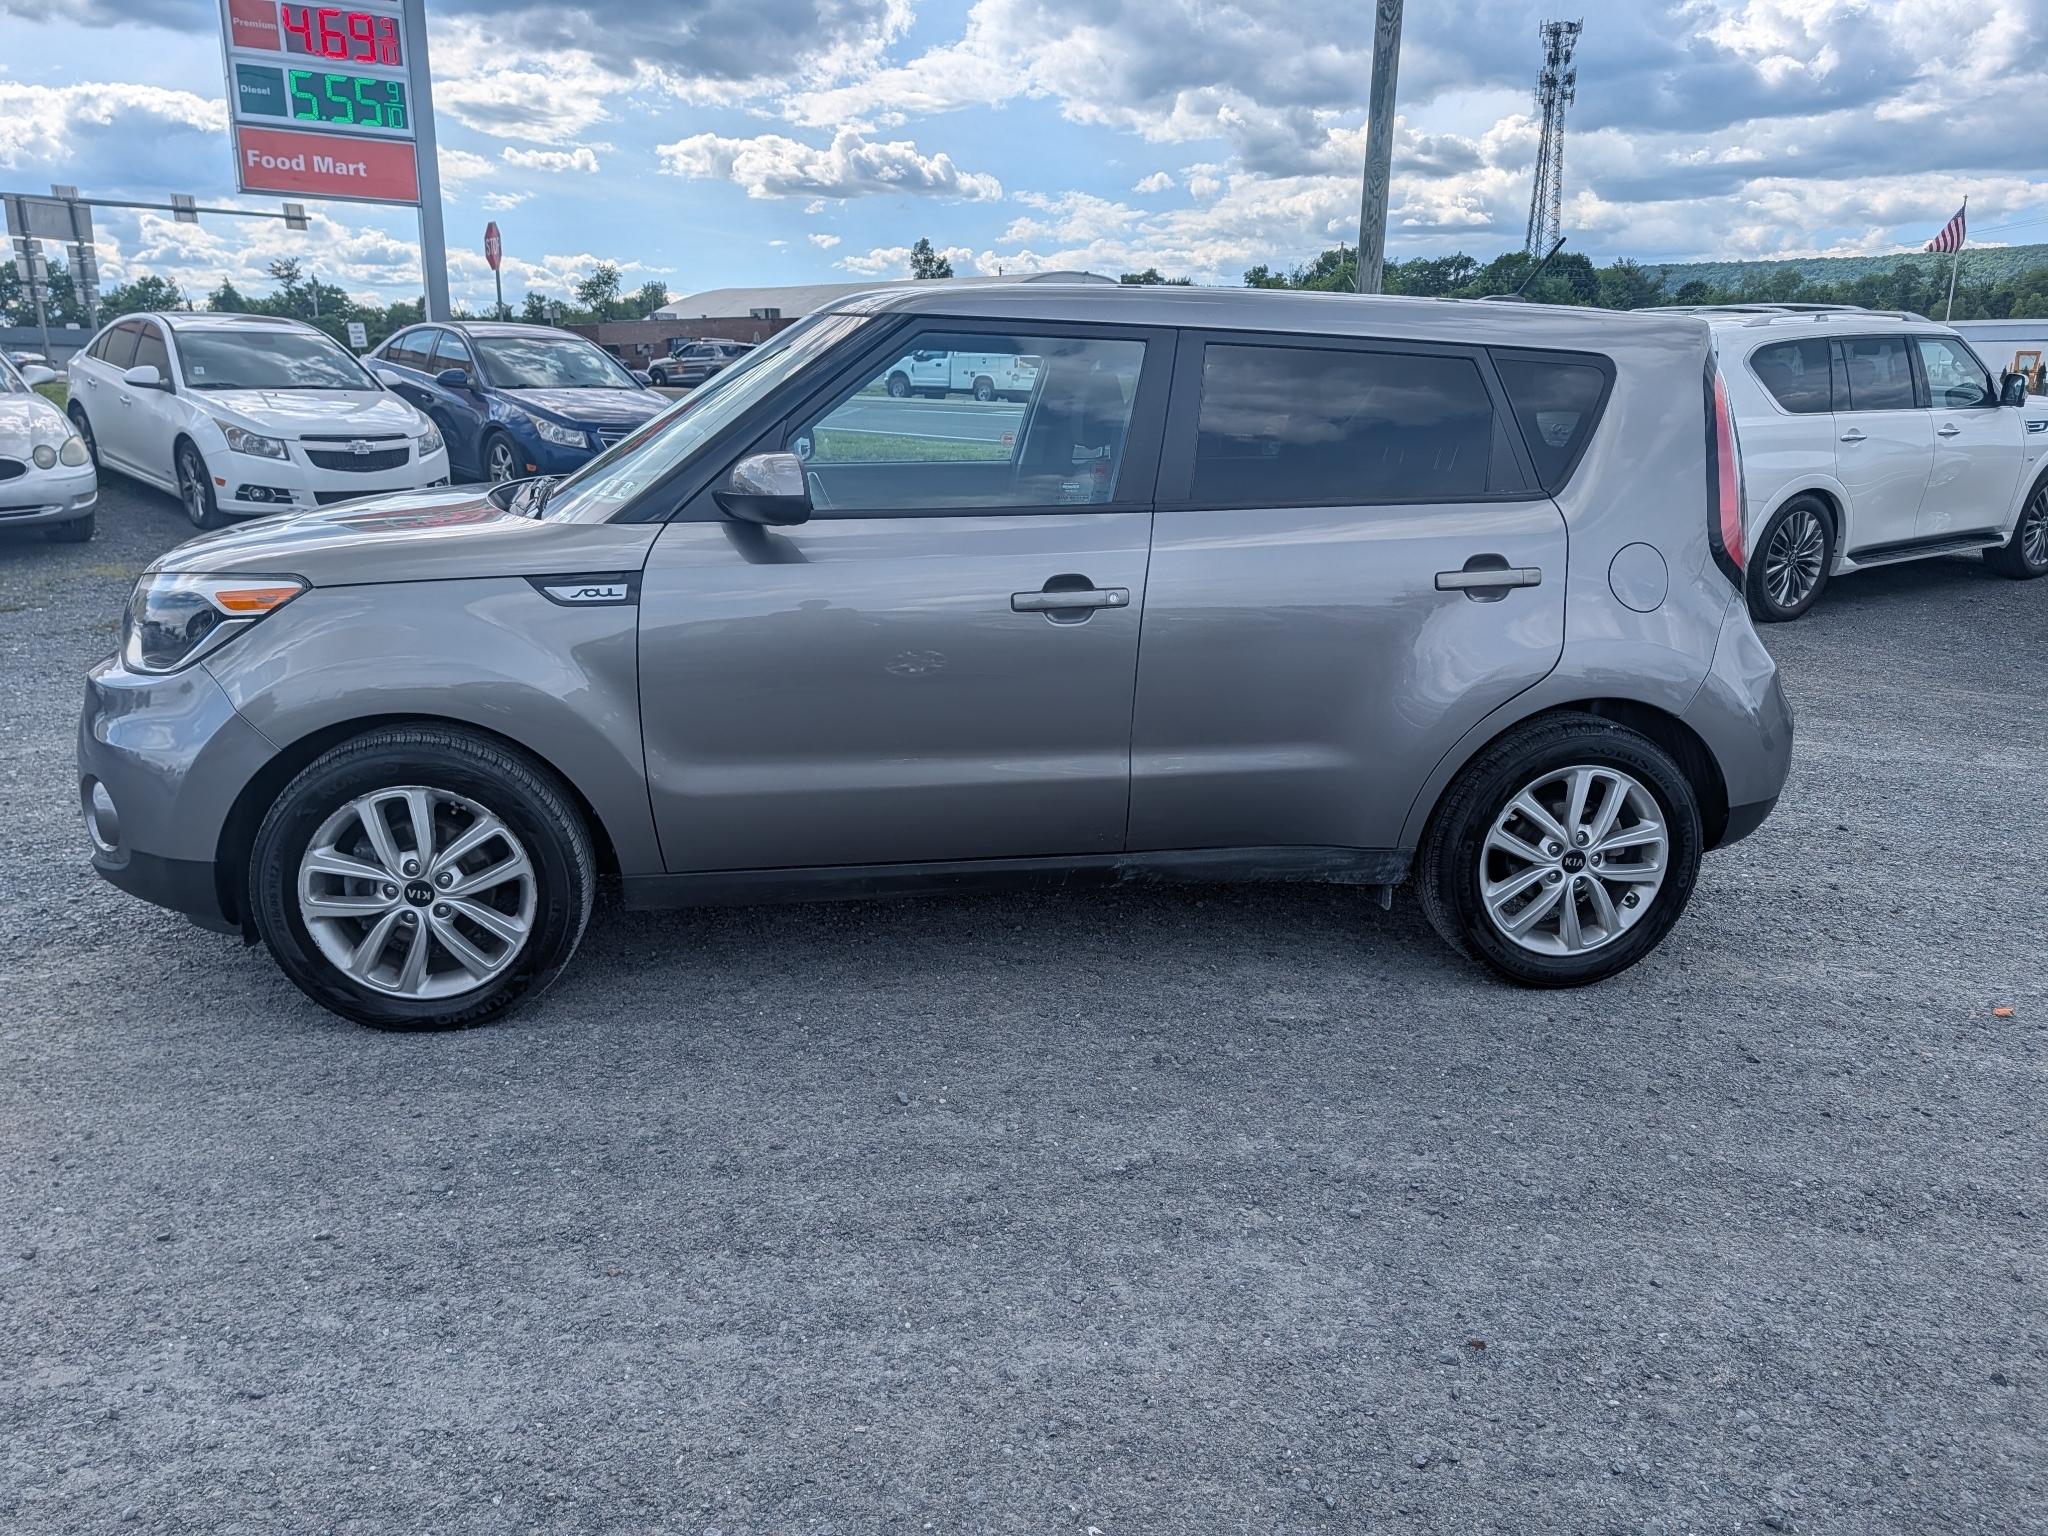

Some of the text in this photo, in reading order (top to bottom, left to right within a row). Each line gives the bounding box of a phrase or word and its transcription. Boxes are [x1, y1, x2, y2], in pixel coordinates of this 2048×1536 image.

[232, 17, 277, 31] Premium
[281, 5, 377, 64] 4.69
[240, 84, 271, 96] Diesel
[289, 70, 383, 127] 5.55
[246, 149, 368, 177] Food Mart
[570, 588, 622, 598] SOUL
[1564, 857, 1584, 867] KIA
[407, 888, 431, 900] KIA
